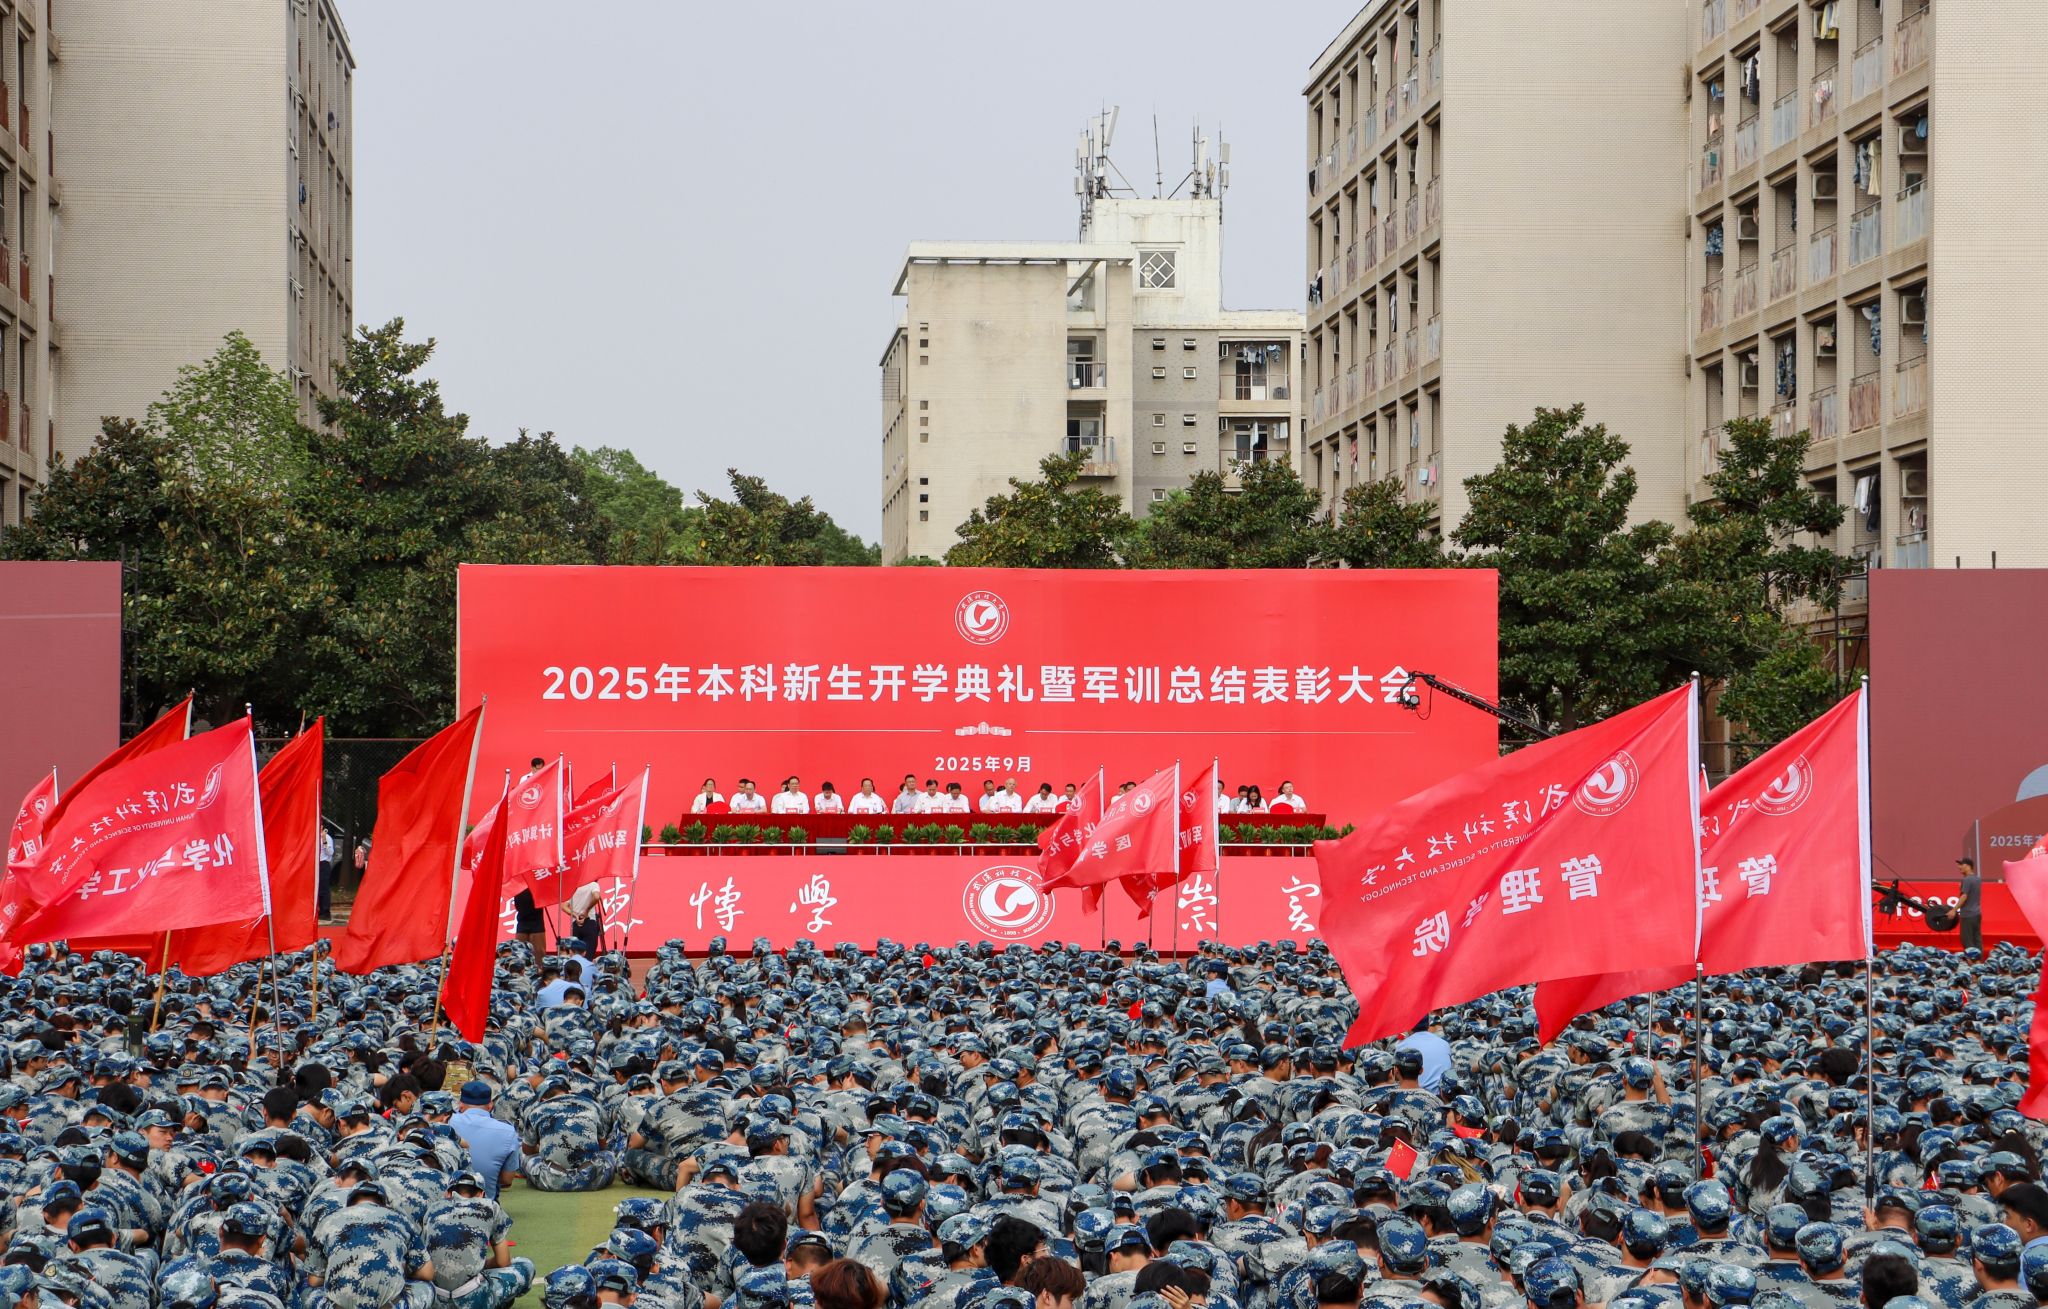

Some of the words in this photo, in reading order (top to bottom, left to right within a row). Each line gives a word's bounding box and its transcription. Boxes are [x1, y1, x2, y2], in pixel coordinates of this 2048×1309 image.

[542, 663, 1417, 704] 2025年本科新生开学典礼暨军训总结表彰大会
[935, 756, 1031, 772] 2025年9月
